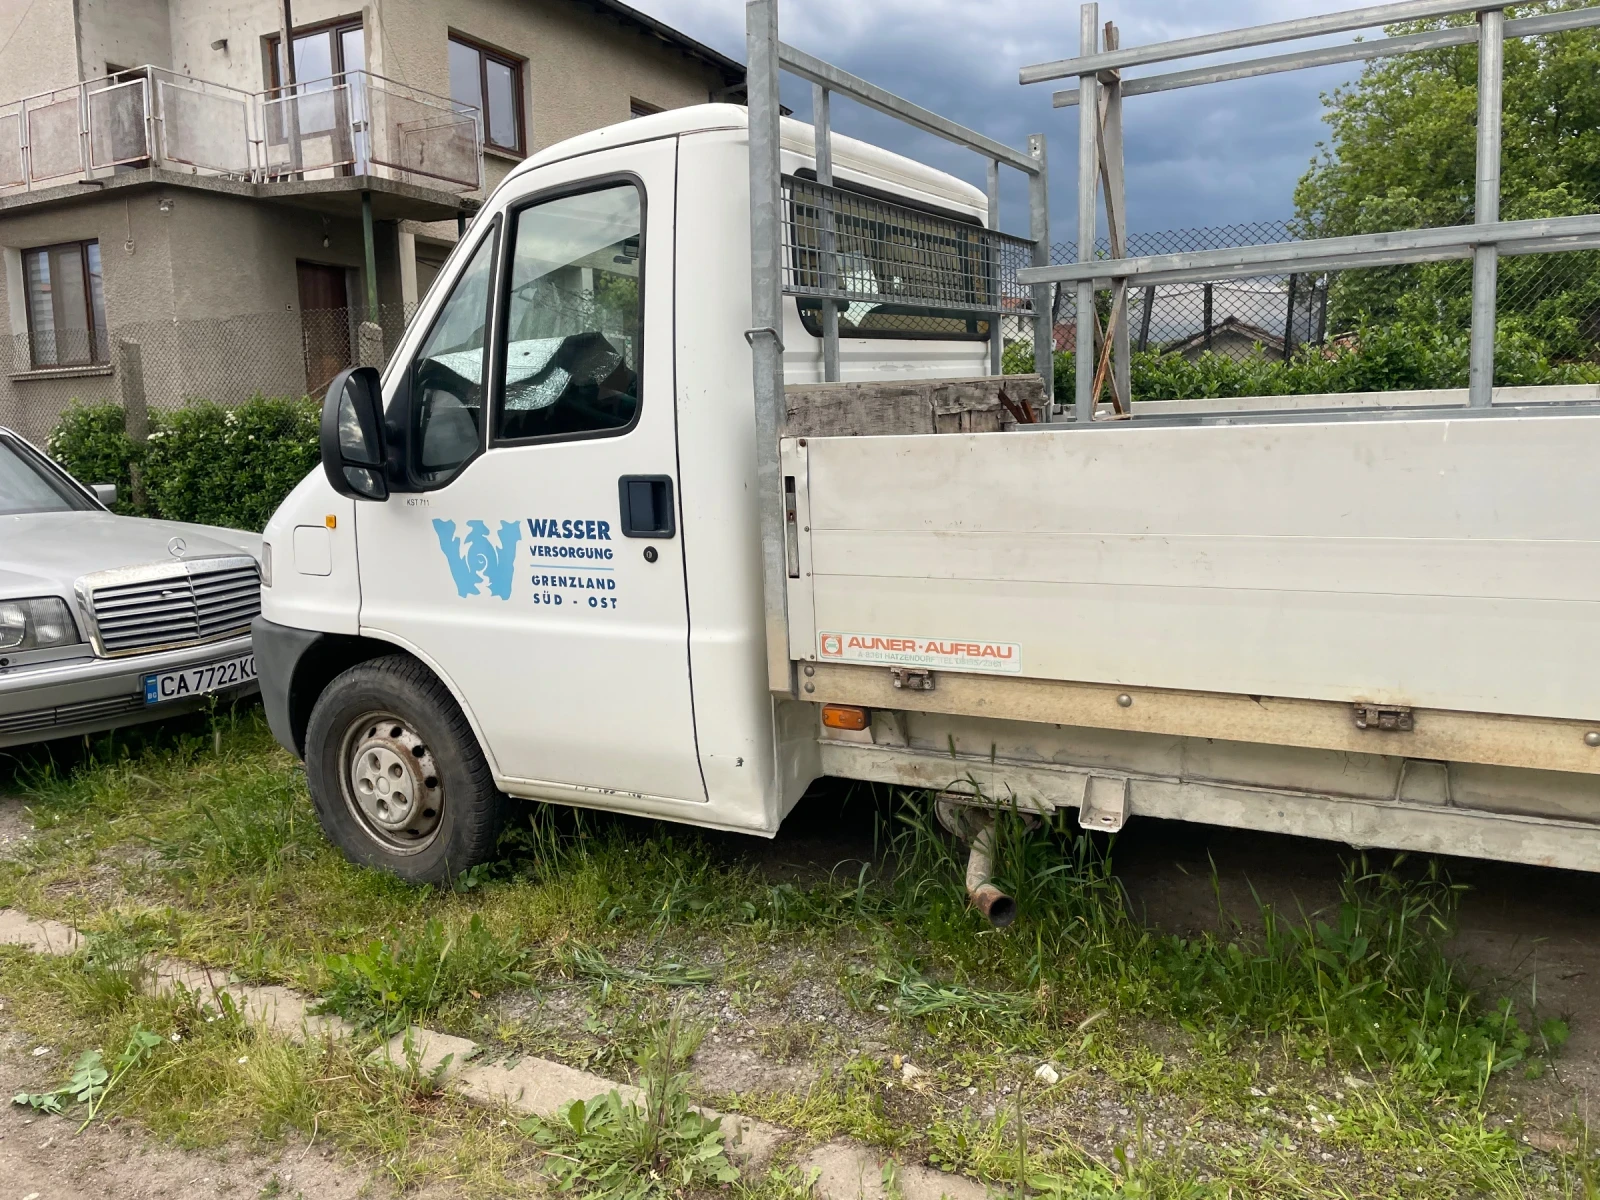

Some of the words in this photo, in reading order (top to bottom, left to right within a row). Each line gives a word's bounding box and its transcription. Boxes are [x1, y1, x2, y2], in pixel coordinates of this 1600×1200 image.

[406, 498, 418, 506] KST
[419, 498, 430, 506] 711
[527, 518, 612, 541] WASSER
[529, 545, 614, 560] VERSORGUNG
[531, 575, 616, 590] GRENZLAND
[533, 590, 563, 606] SÜD
[588, 596, 617, 609] OST
[884, 652, 935, 663] HATZENDORF
[161, 673, 190, 697] CA
[193, 662, 238, 691] 7722
